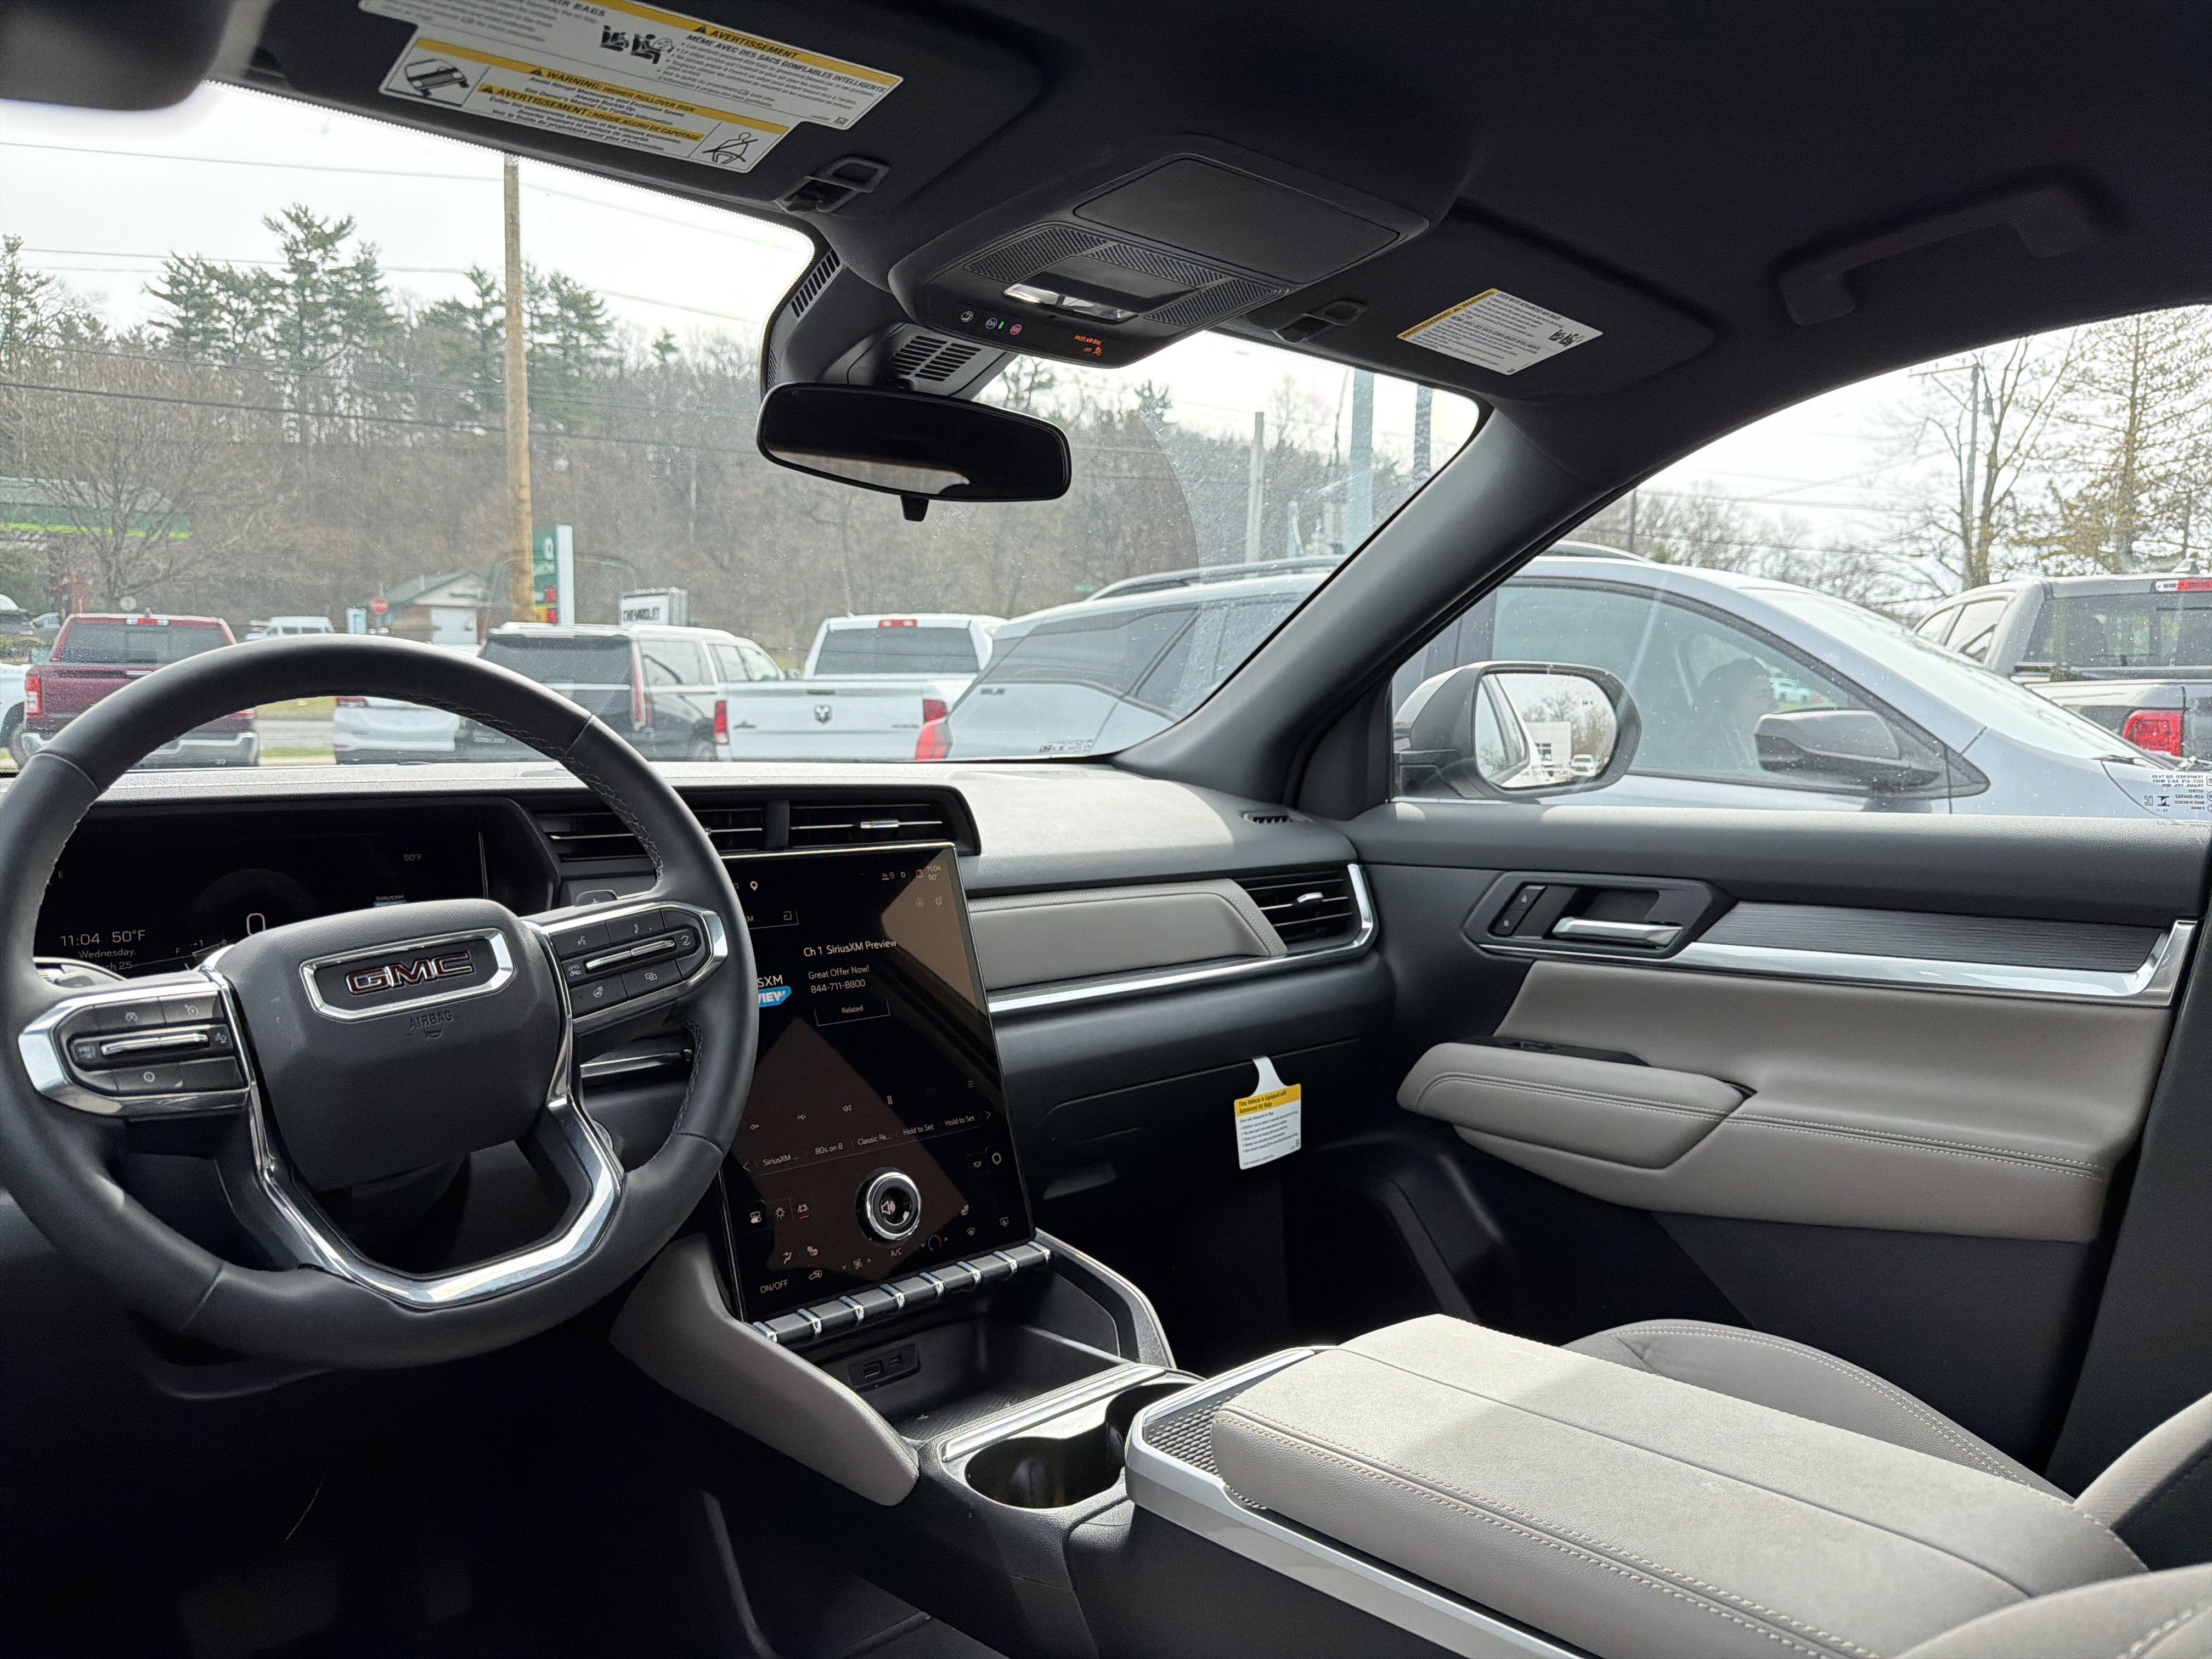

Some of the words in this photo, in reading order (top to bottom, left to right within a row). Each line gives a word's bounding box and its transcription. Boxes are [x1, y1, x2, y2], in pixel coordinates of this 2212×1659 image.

[573, 3, 606, 17] BAGS
[710, 30, 797, 58] AVERTISSEMENT
[715, 42, 739, 54] AVEC
[738, 48, 756, 58] DES
[757, 53, 781, 65] SACS
[781, 60, 833, 79] GONFLABLES
[832, 74, 887, 94] INTELLIGENTS
[634, 93, 675, 109] ROLLOVER
[676, 104, 695, 113] RISK
[496, 88, 587, 115] AVERTISSEMENT
[591, 111, 620, 123] RISQUE
[659, 128, 701, 143] CAPOTAGE
[60, 933, 101, 947] 11:04
[112, 930, 146, 943] 50°F
[803, 947, 816, 957] Ch
[818, 946, 823, 955] 1
[826, 941, 864, 955] SiriusXM
[865, 940, 897, 950] Preview
[119, 961, 132, 970] 25
[808, 970, 829, 980] Great
[830, 967, 849, 978] Offer
[851, 964, 870, 974] Now!
[346, 951, 476, 996] GMC
[810, 979, 866, 994] 844-711-8800
[842, 1005, 864, 1014] Related
[409, 1011, 453, 1029] AIRBAG
[903, 1126, 917, 1136] Hold
[924, 1124, 934, 1132] Set
[945, 1118, 958, 1127] Hold
[815, 1146, 830, 1155] 80s
[829, 1144, 838, 1153] on
[838, 1142, 844, 1150] 8
[857, 1136, 879, 1146] Classic
[763, 1154, 792, 1166] SiriusXM
[890, 1247, 903, 1257] A/C
[760, 1279, 788, 1294] ON/OFF
